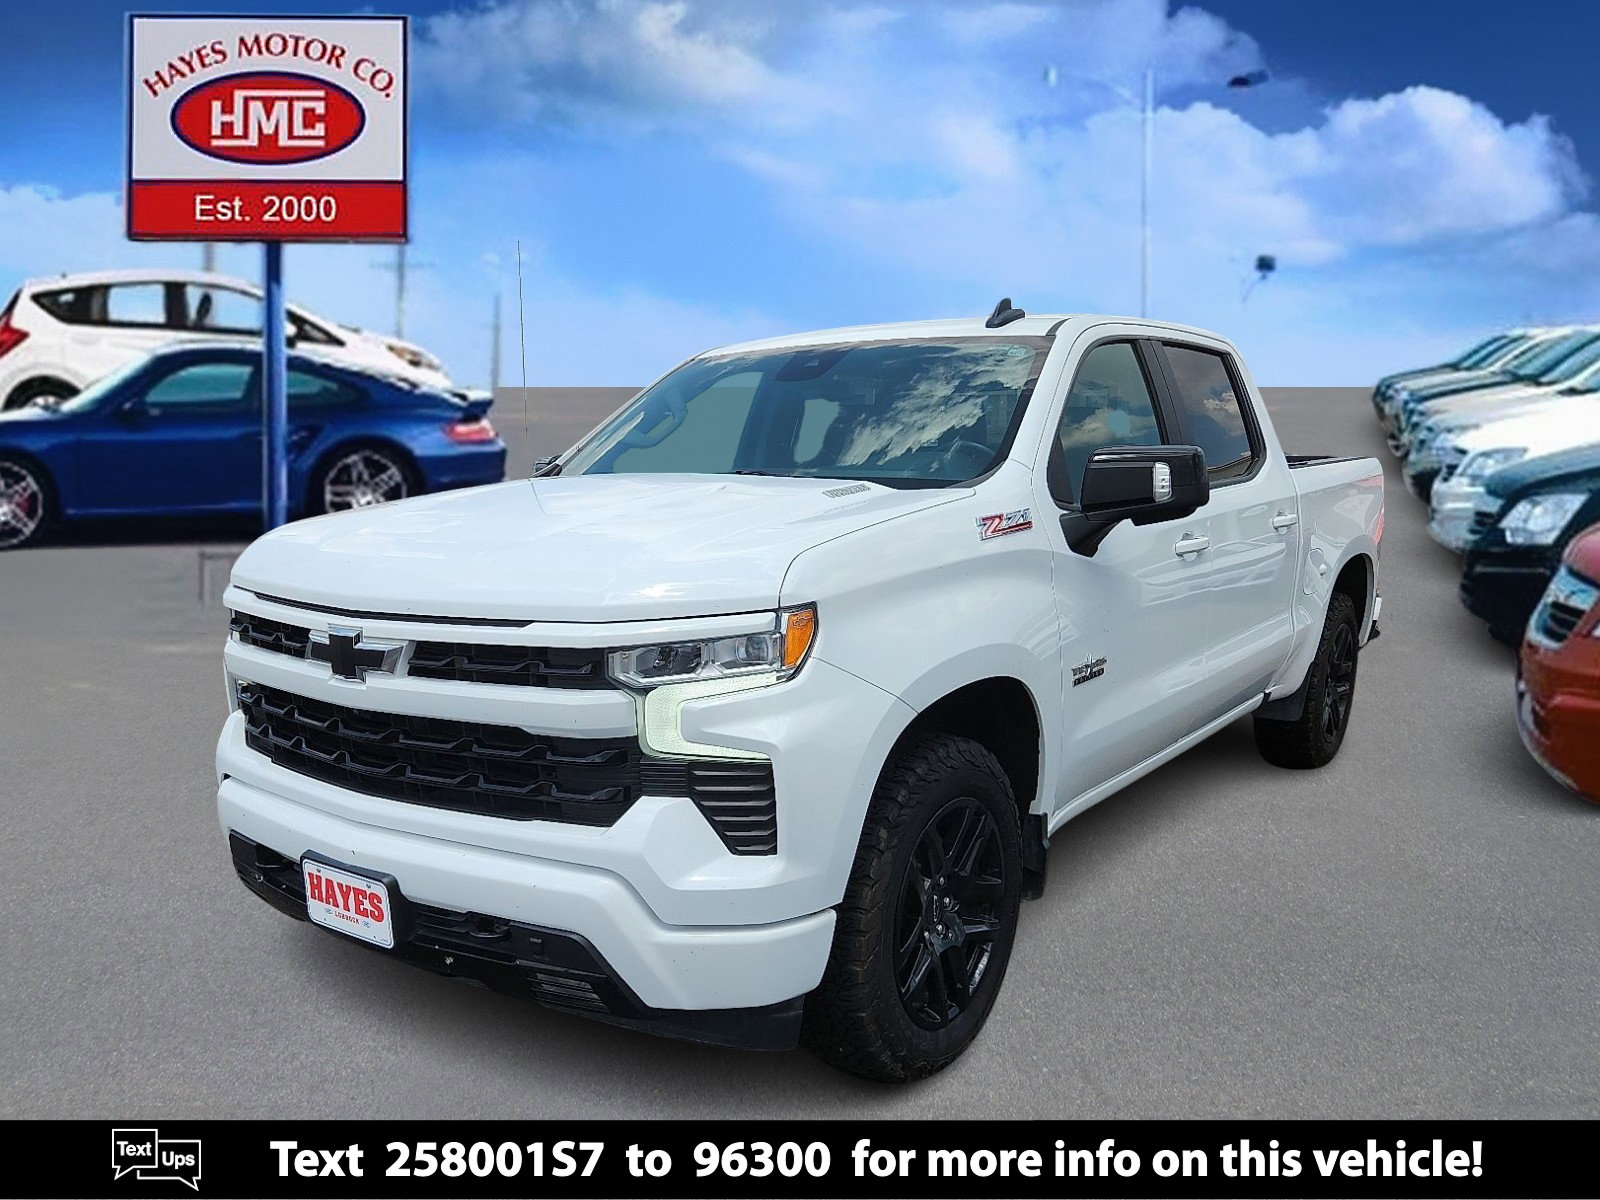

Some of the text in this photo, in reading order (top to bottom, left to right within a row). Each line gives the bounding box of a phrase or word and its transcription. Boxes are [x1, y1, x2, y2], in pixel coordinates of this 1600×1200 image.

[142, 32, 395, 98] HAYES MOTOR CO.
[210, 89, 326, 147] HMC
[194, 194, 337, 222] Est. 2000
[307, 872, 385, 923] HAYES
